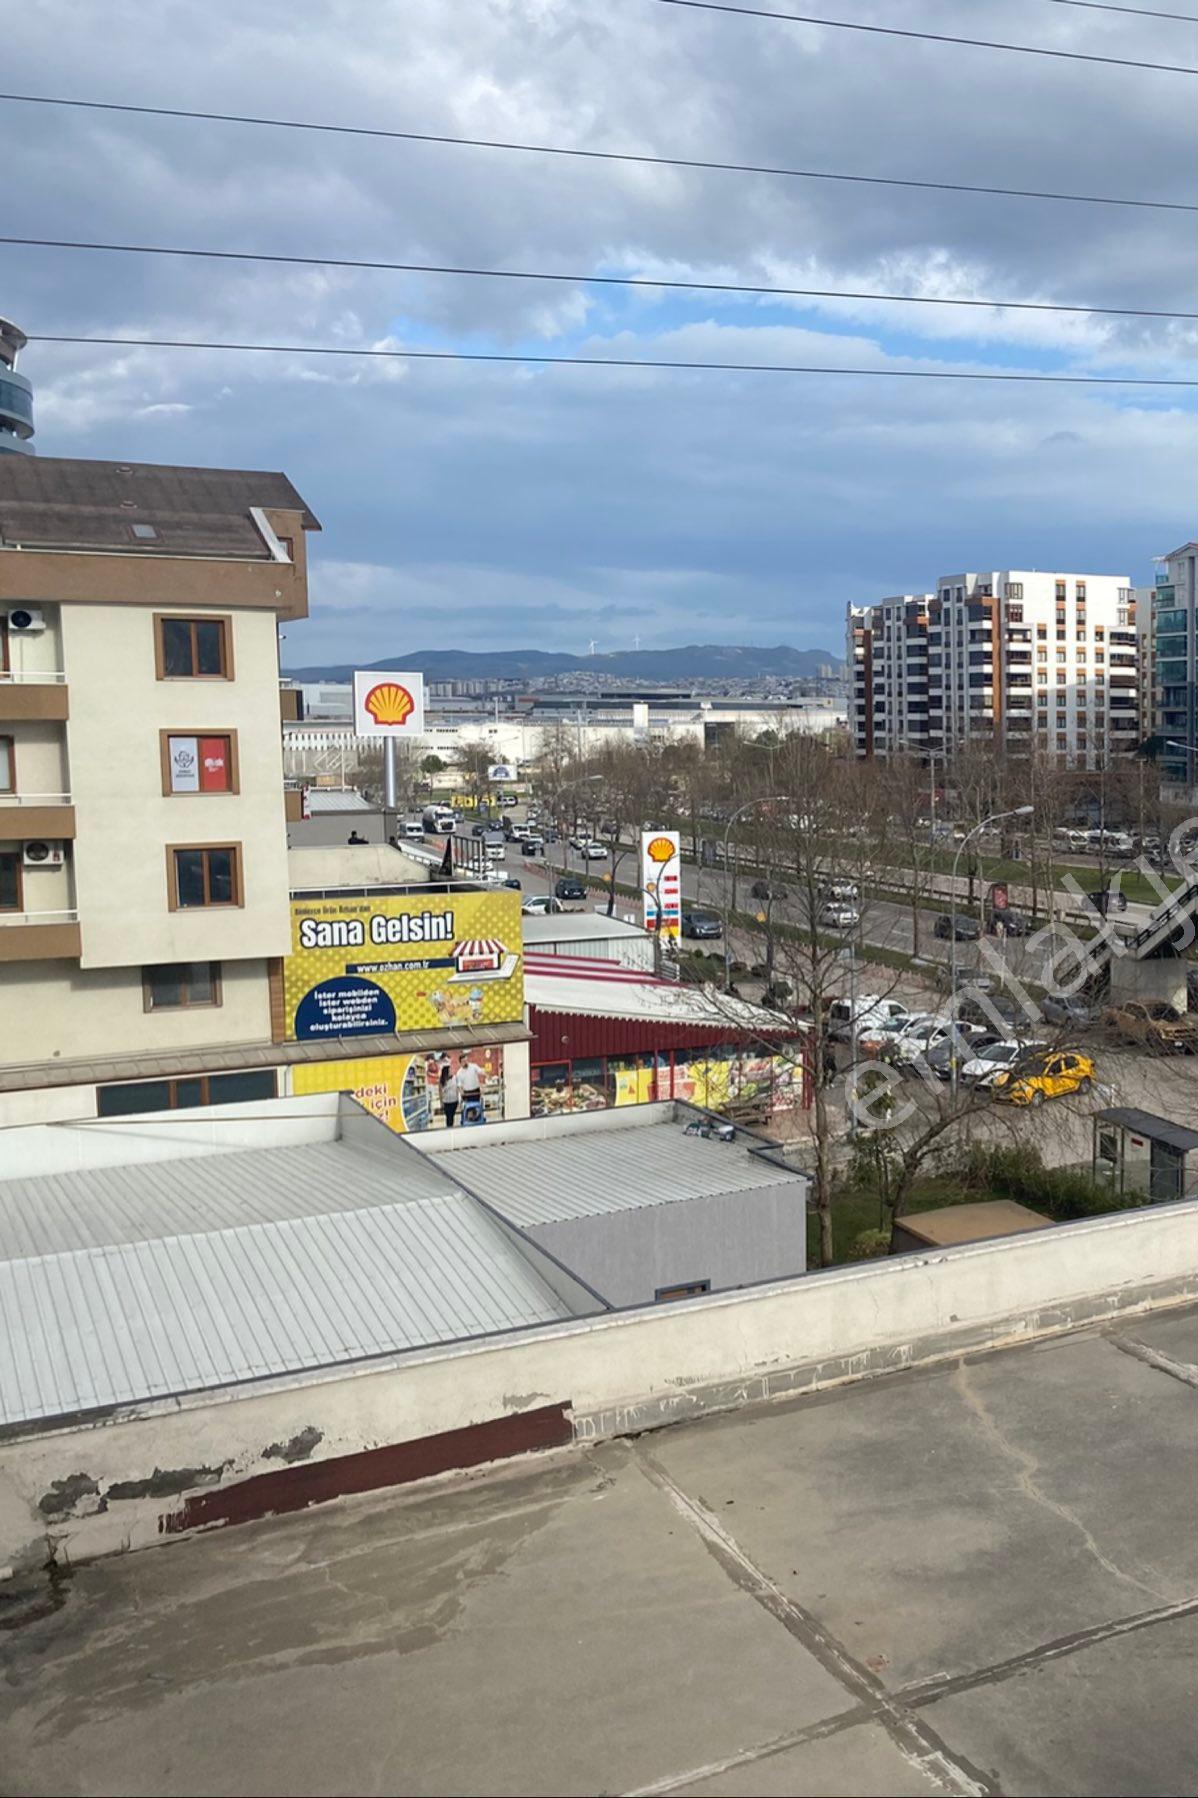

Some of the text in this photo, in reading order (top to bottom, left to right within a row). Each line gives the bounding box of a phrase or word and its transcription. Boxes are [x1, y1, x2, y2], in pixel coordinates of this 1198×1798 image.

[300, 911, 454, 948] Sana Gelsin!
[371, 1096, 397, 1110] için
